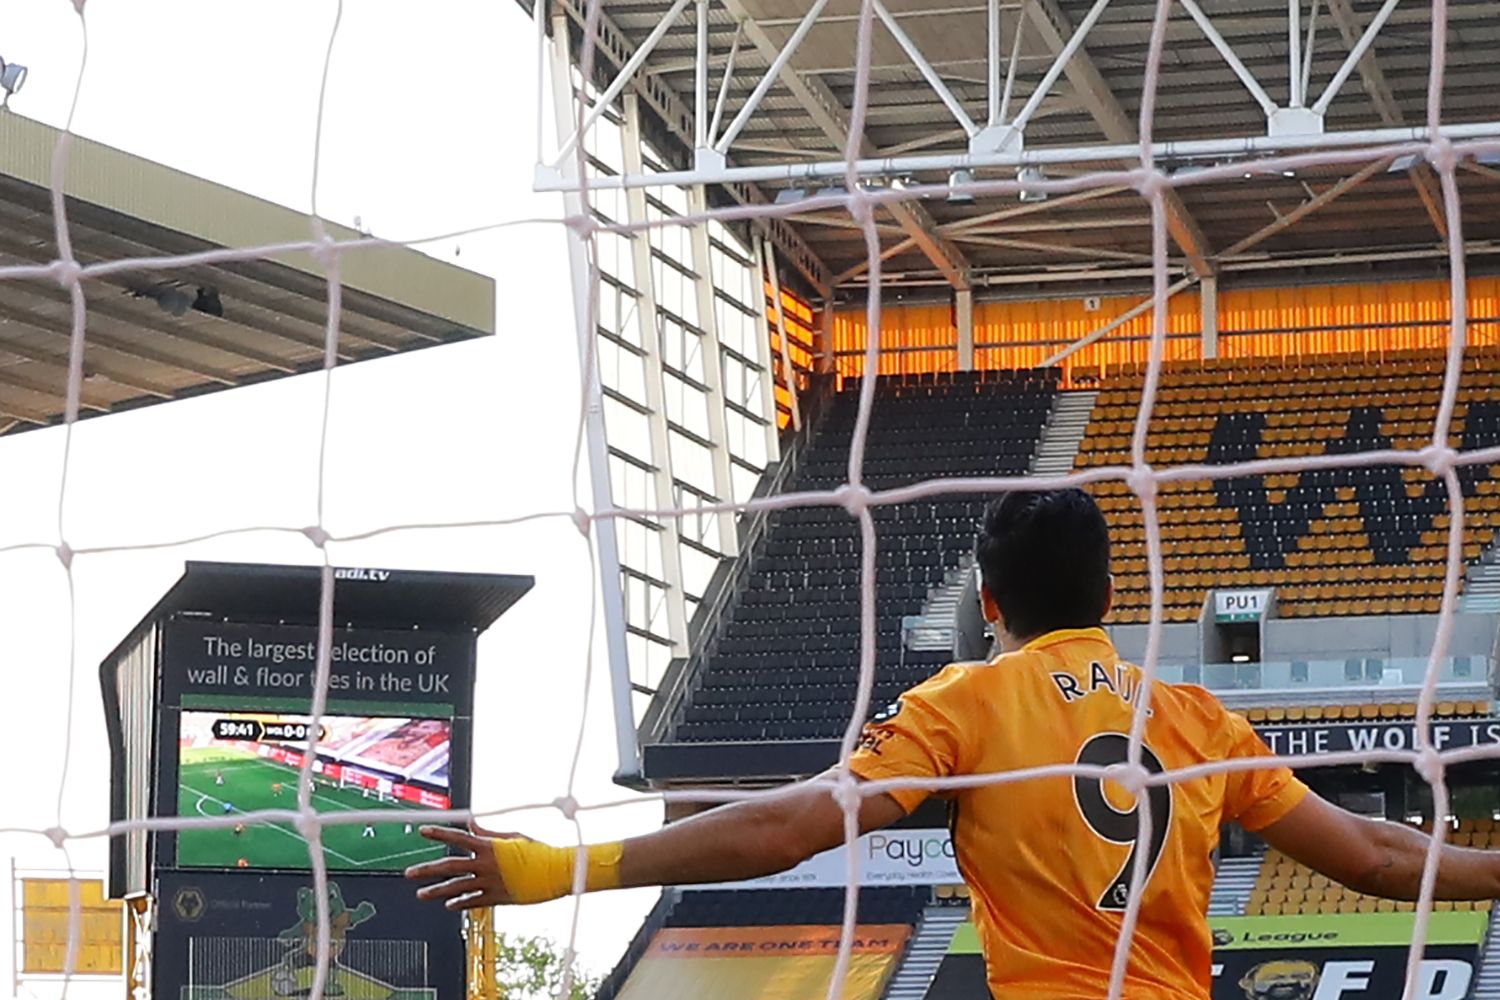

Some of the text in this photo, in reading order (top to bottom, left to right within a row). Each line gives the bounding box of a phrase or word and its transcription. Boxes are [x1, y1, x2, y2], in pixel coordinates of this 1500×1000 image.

[1225, 596, 1259, 610] PU1
[204, 637, 436, 665] The largest election of
[187, 666, 449, 693] wall & floor tes in the UK
[220, 722, 254, 736] 59:41
[1264, 730, 1329, 754] THE
[1071, 731, 1173, 912] 9
[702, 941, 757, 952] ARE
[818, 938, 889, 950] TAM
[1242, 931, 1340, 943] League
